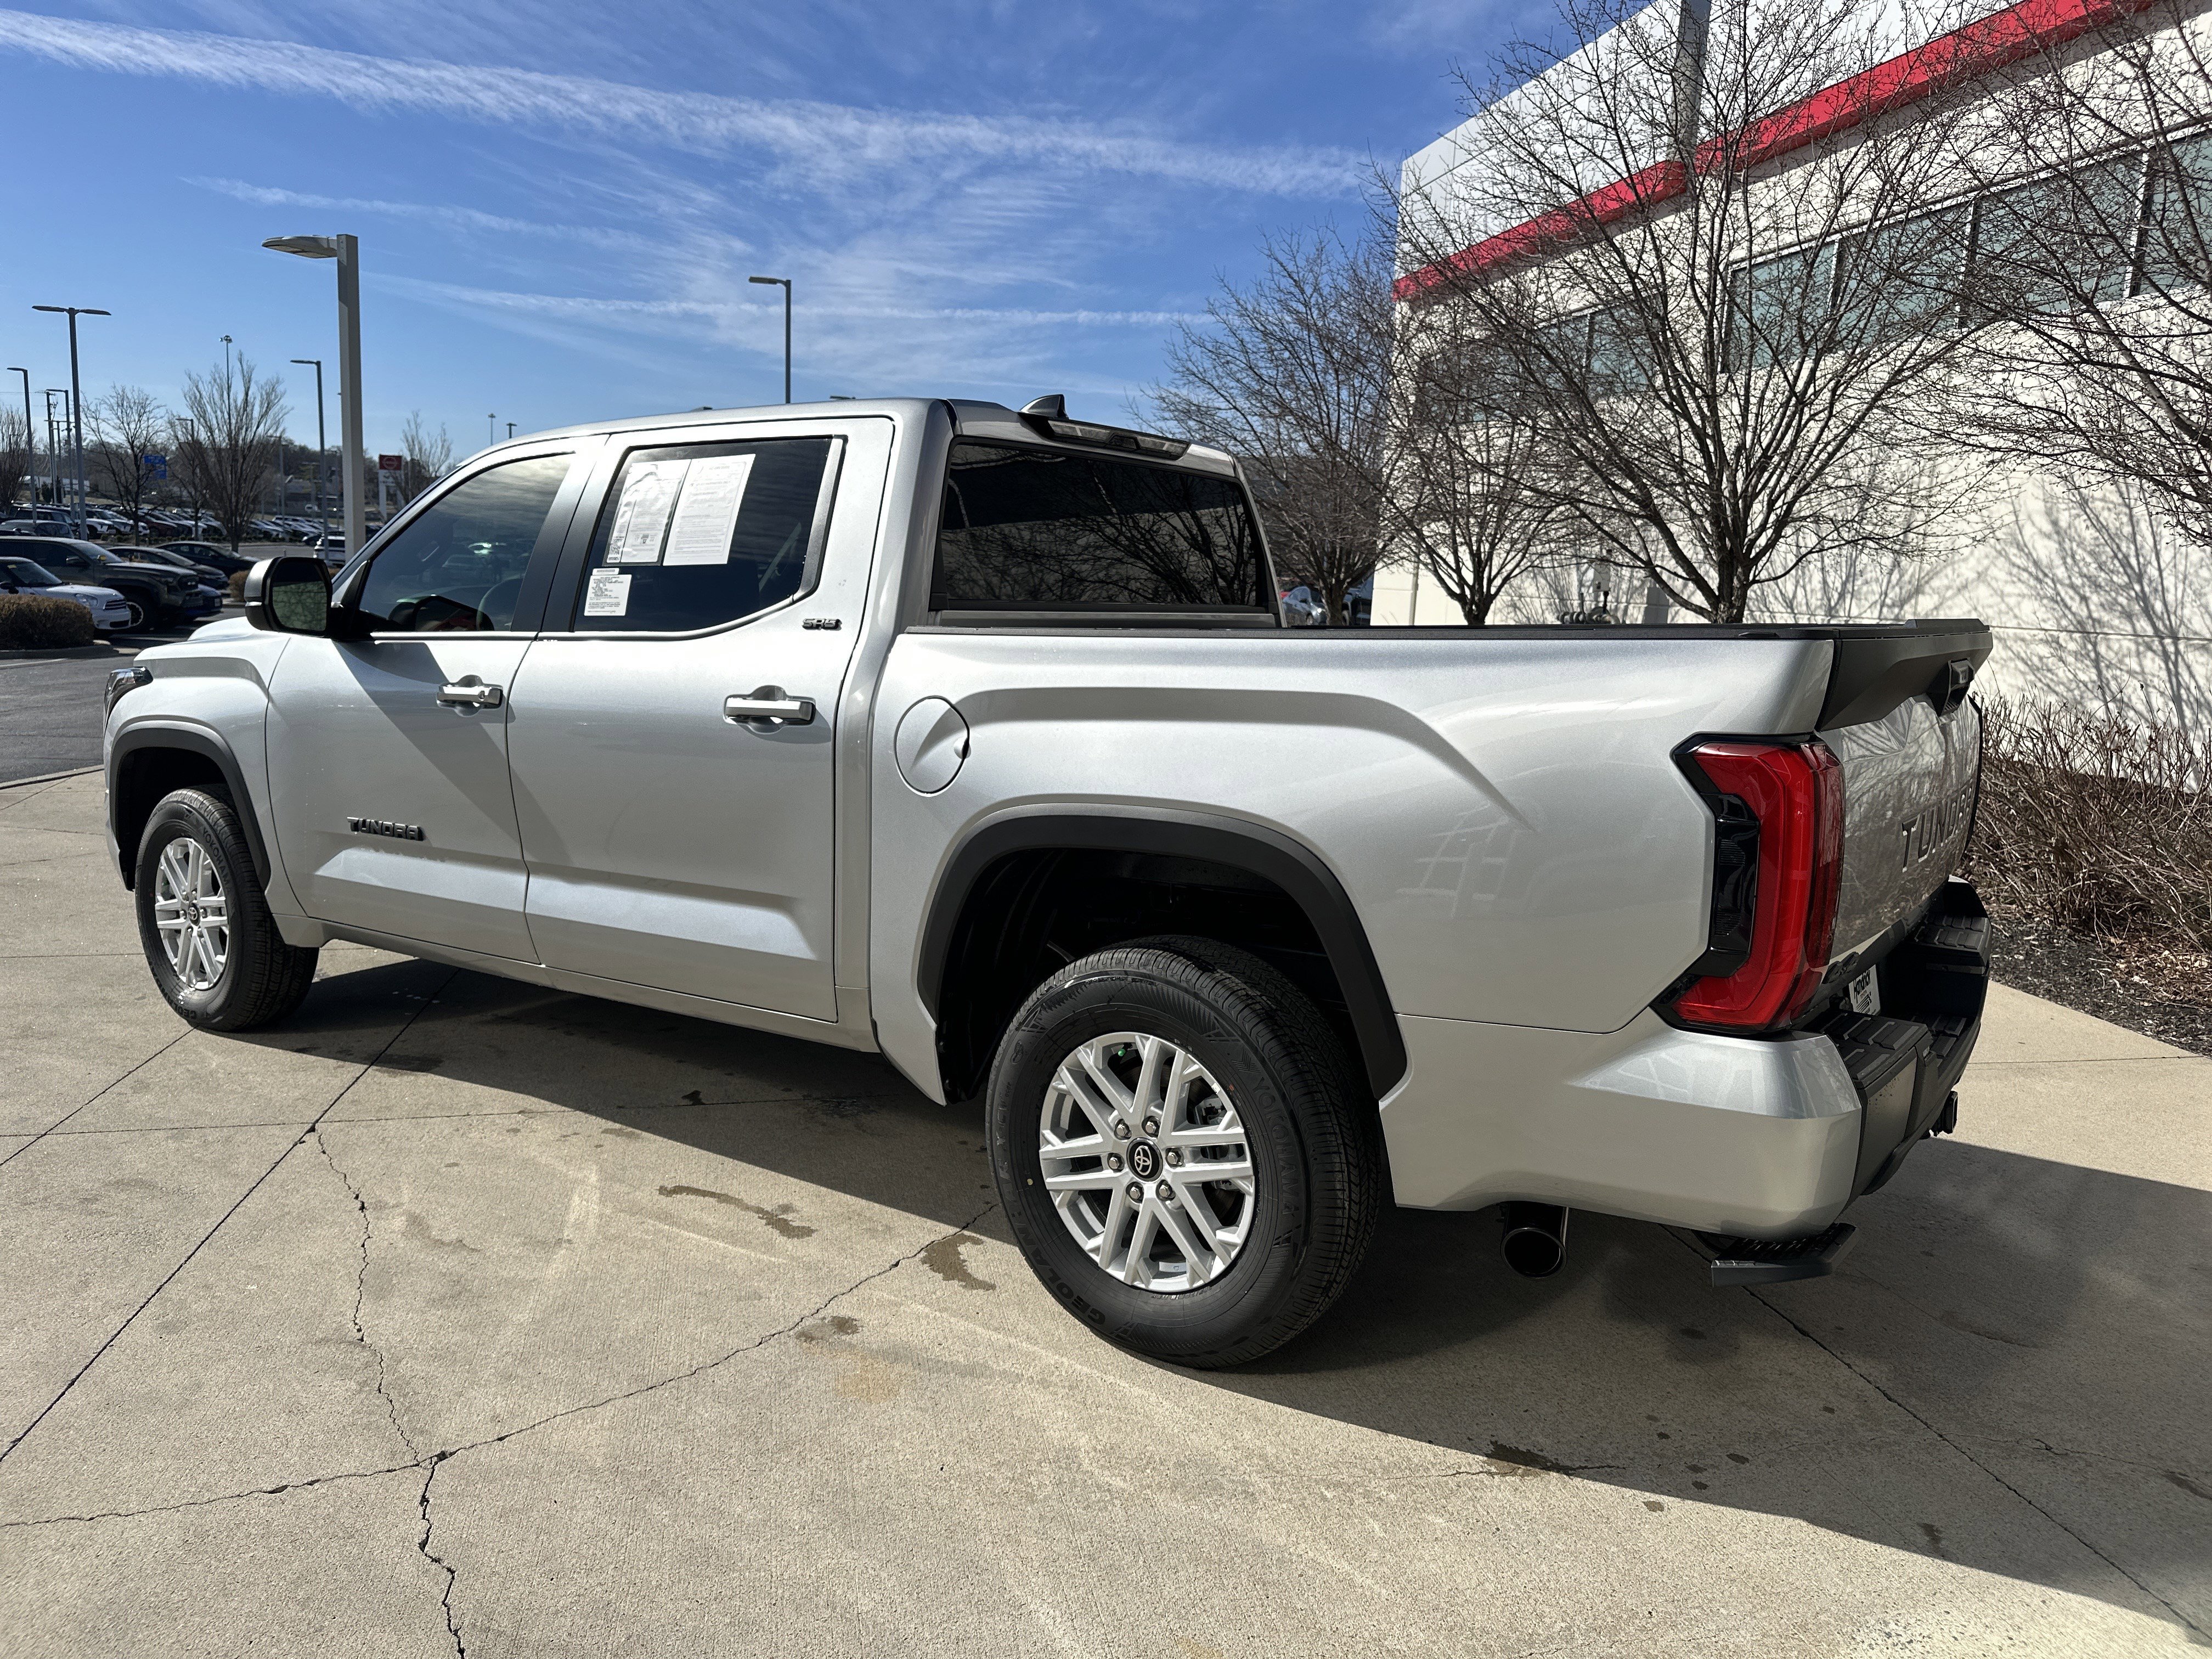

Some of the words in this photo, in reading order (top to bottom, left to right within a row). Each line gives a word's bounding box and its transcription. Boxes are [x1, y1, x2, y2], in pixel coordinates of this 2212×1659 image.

[802, 618, 839, 630] SR5
[347, 816, 422, 841] TUNDRA
[1251, 1076, 1299, 1216] YOKOHAMA
